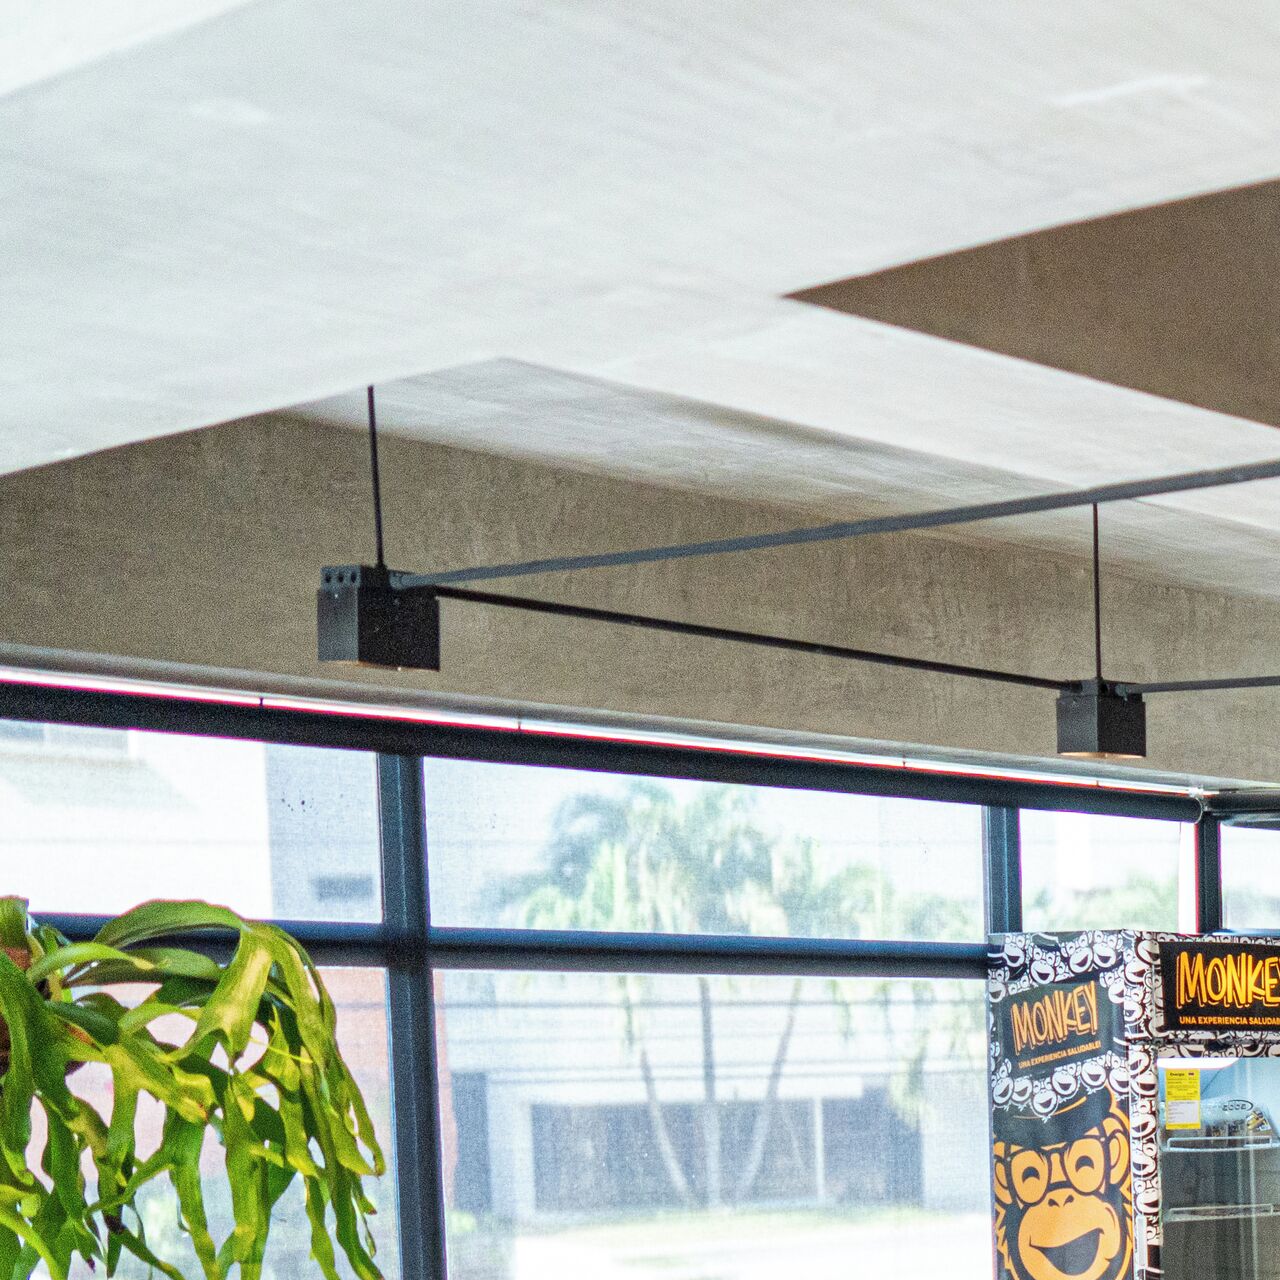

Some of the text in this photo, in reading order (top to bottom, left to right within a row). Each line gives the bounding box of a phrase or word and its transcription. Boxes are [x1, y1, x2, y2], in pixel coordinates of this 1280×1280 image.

[1011, 980, 1098, 1056] MONKEY
[1180, 1016, 1196, 1025] UNA
[1198, 1016, 1247, 1025] EXPERIENCIA
[1019, 1059, 1031, 1069] UNA
[1031, 1050, 1067, 1066] EXPERIENCIA
